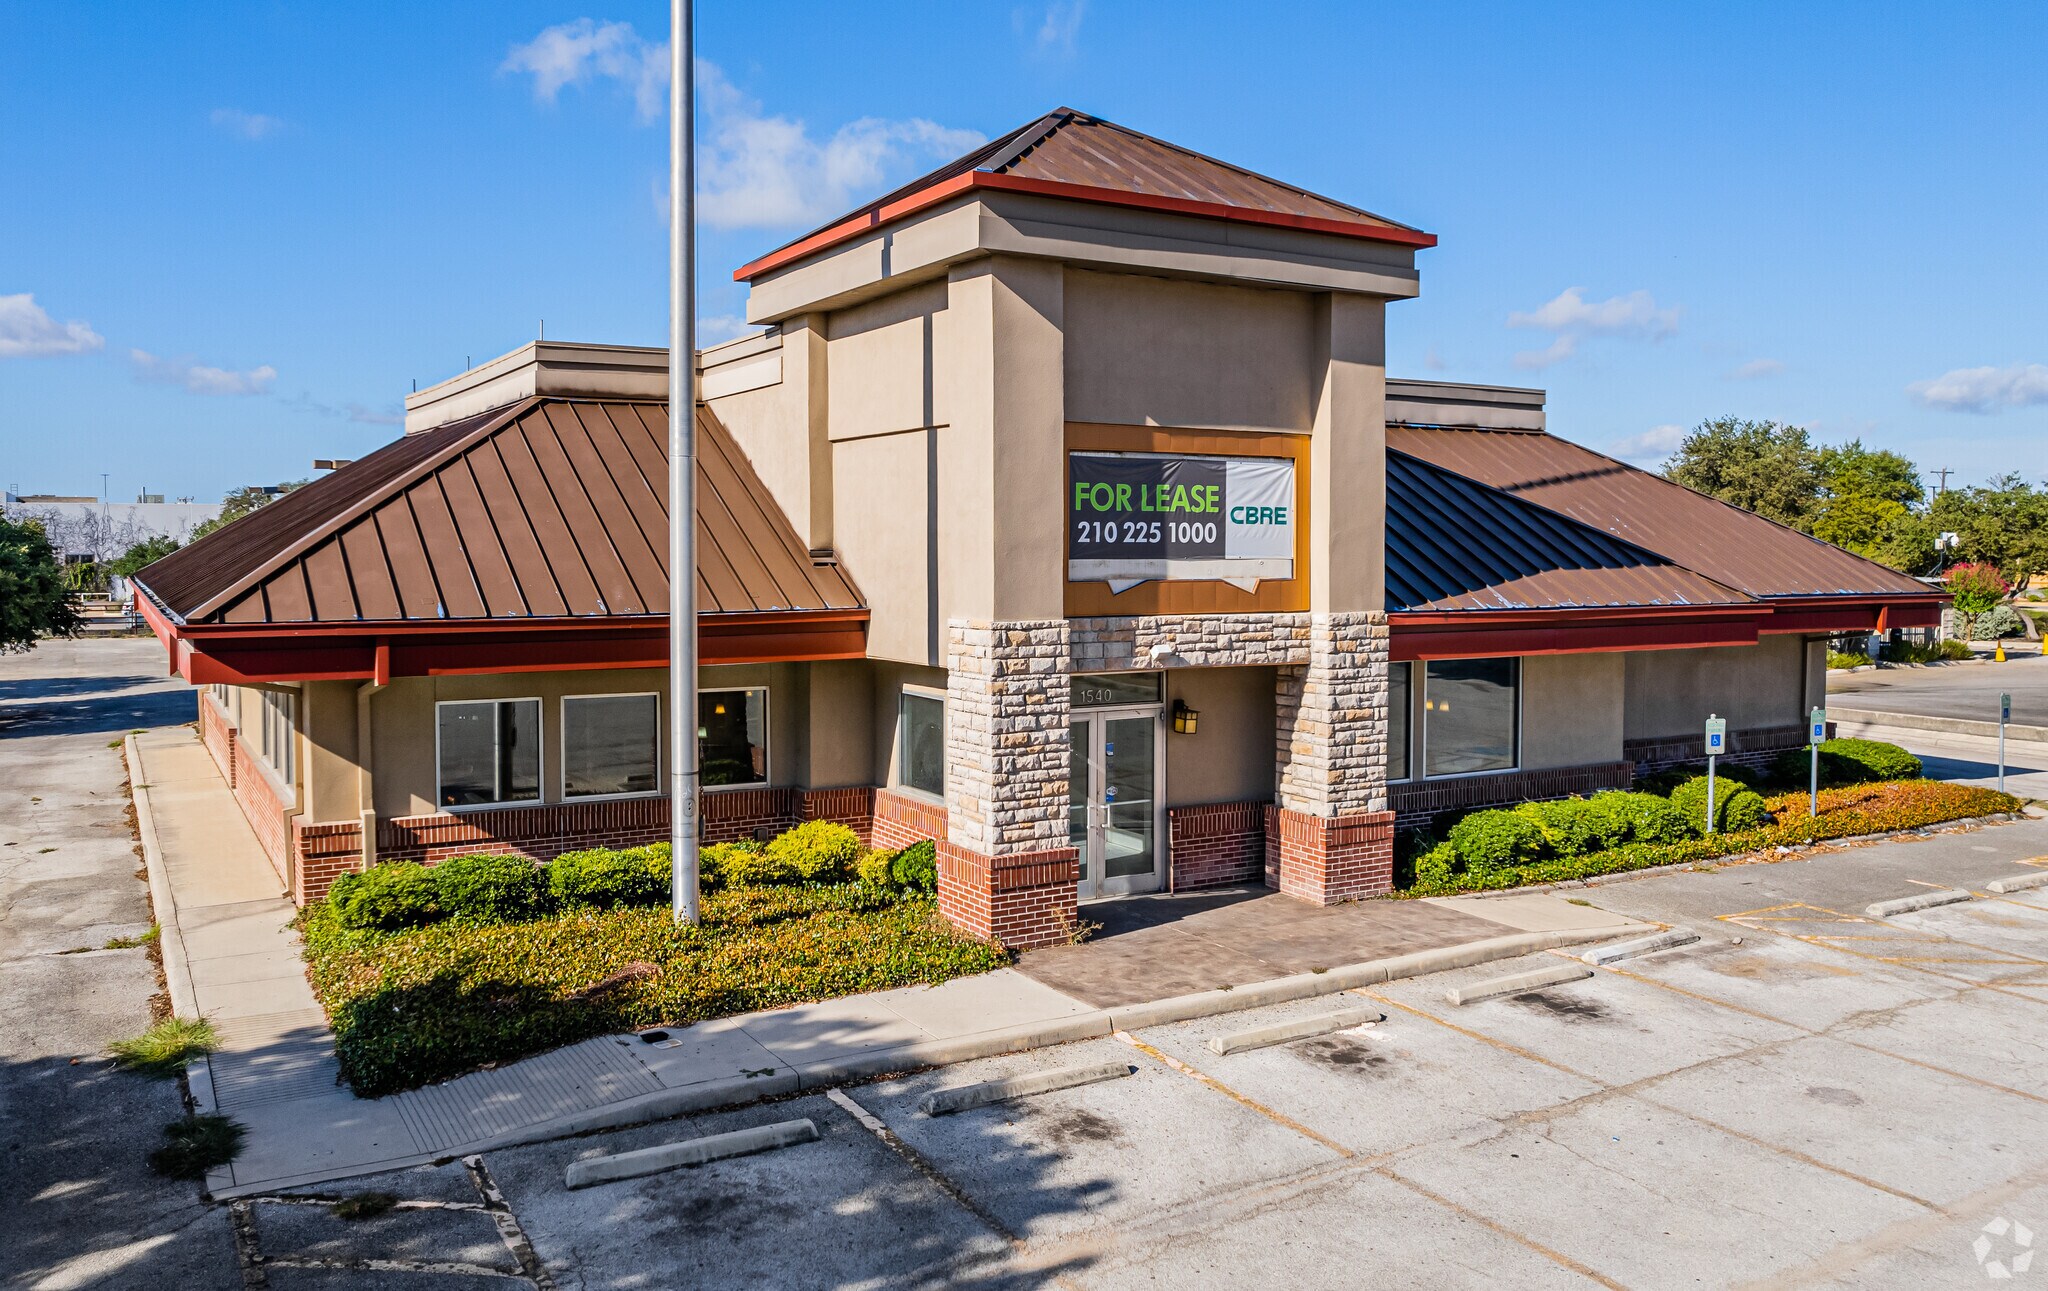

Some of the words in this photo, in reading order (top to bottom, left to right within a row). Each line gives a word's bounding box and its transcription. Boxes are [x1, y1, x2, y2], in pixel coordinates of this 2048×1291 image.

[1075, 482, 1132, 512] FOR
[1141, 484, 1220, 513] LEASE
[1230, 506, 1288, 525] CBRE
[1077, 521, 1118, 543] 210
[1123, 521, 1162, 543] 225
[1169, 522, 1217, 544] 1000
[1080, 689, 1112, 703] 1540
